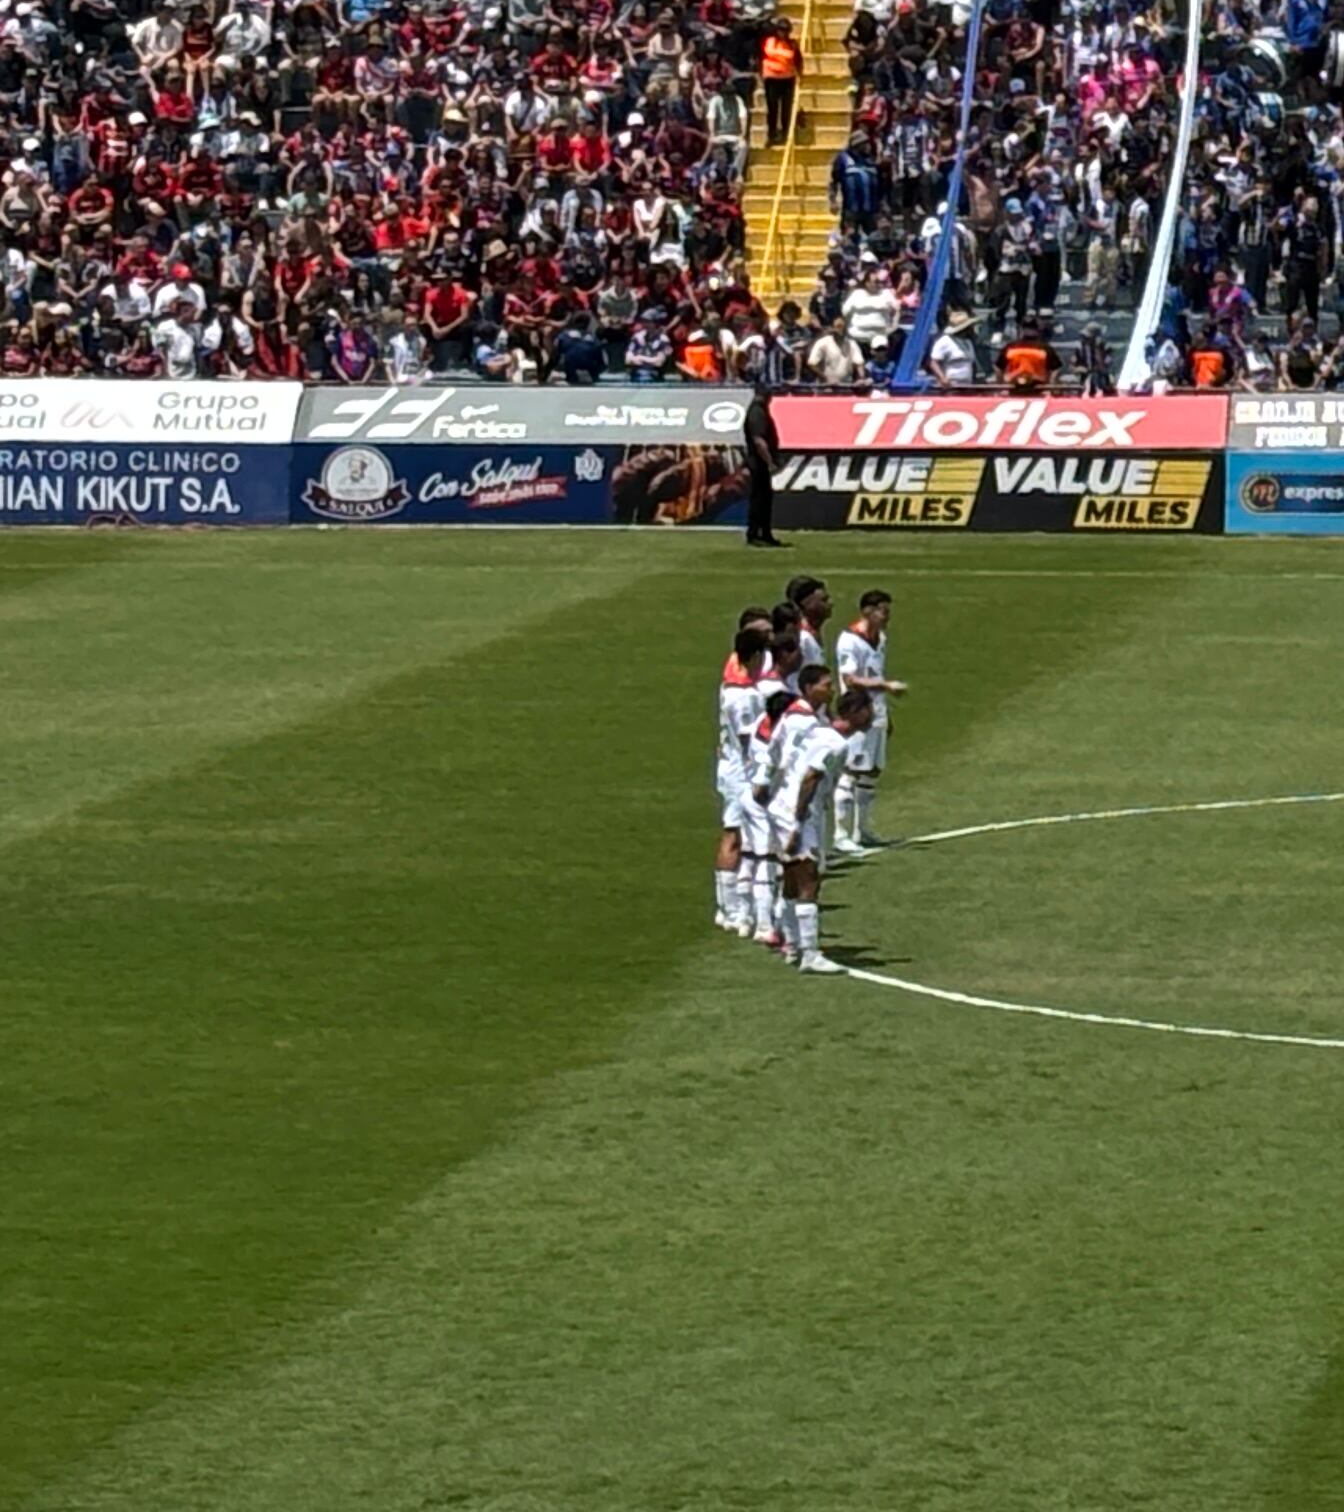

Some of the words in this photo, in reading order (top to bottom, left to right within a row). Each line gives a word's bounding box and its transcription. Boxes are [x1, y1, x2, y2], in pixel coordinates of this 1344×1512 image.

[158, 392, 260, 419] Grupo
[152, 412, 267, 431] Mutual
[852, 399, 1147, 447] Tioflex
[128, 450, 241, 473] CLINICO
[418, 472, 459, 504] Con
[461, 456, 543, 497] Salqui
[994, 456, 1157, 495] VALUE
[0, 474, 63, 511] IAN
[77, 476, 173, 513] KIKUT
[180, 478, 241, 514] S.A.
[857, 496, 964, 522] MILES
[1083, 499, 1191, 525] MILES
